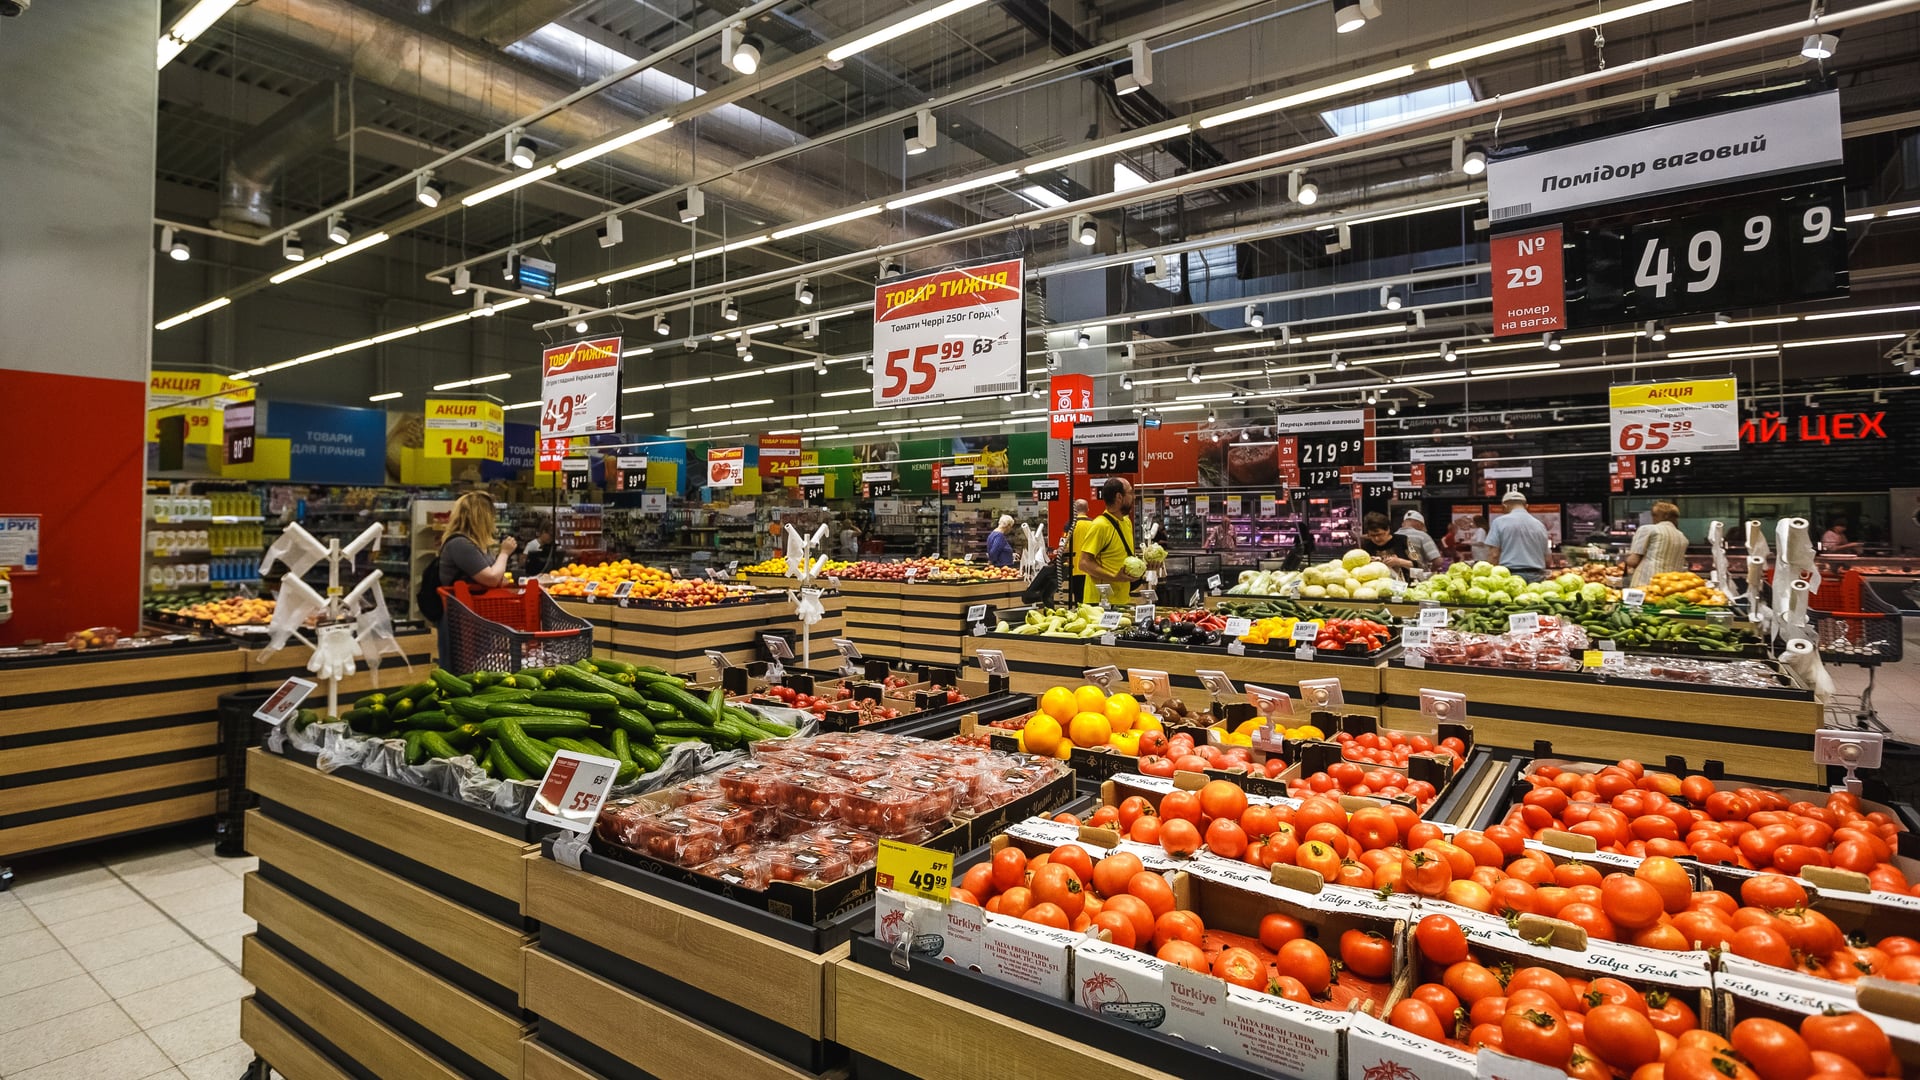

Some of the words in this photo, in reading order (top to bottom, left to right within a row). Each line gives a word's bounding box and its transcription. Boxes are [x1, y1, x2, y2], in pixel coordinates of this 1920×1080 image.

[1541, 159, 1646, 193] Помідор
[1652, 135, 1767, 171] ваговий
[1634, 230, 1723, 299] 49
[1506, 265, 1543, 290] 29
[885, 284, 937, 309] ТОВАР
[940, 271, 1008, 298] ТИЖНЯ
[1507, 304, 1551, 318] номер
[891, 321, 920, 333] Томати
[921, 315, 945, 328] Черрі
[946, 313, 967, 324] 250г
[1501, 319, 1518, 330] на
[1520, 315, 1557, 329] вагах
[549, 352, 576, 367] ТОВАР
[577, 345, 613, 362] ТИЖНЯ
[882, 344, 939, 398] 55
[941, 341, 964, 360] 99
[150, 377, 201, 392] АКЦІЯ
[436, 404, 477, 417] АКЦІЯ
[542, 395, 574, 432] 49
[1053, 414, 1077, 423] ВАГИ
[1080, 414, 1093, 423] ВАГИ
[191, 416, 209, 427] 99
[1799, 411, 1887, 445] ЦЕХ
[307, 431, 353, 443] ТОВАРИ
[1619, 422, 1670, 451] 65
[291, 443, 317, 454] ДЛЯ
[319, 446, 366, 457] ПРАННЯ
[442, 438, 468, 456] 14
[469, 435, 484, 444] 49
[1303, 443, 1337, 463] 219
[1100, 453, 1117, 470] 59
[1147, 451, 1174, 460] М'ЯСО
[770, 462, 789, 473] 24
[1640, 459, 1671, 475] 168
[1310, 471, 1324, 484] 12
[1438, 469, 1453, 482] 19
[1634, 478, 1649, 489] 32
[1369, 486, 1381, 496] 35
[7, 521, 37, 531] РУК
[569, 791, 593, 812] 55
[1189, 861, 1218, 876] Talya
[1219, 869, 1250, 883] Fresh
[909, 870, 935, 892] 49
[935, 875, 947, 886] 99
[1319, 892, 1352, 906] Talya
[1354, 898, 1389, 912] Fresh
[947, 914, 982, 932] Türkiye
[994, 940, 1011, 950] TALYA
[1011, 945, 1031, 956] FRESH
[1587, 954, 1630, 972] Talya
[1635, 963, 1679, 979] Fresh
[1170, 994, 1195, 1007] Discover
[1171, 981, 1217, 1005] Türkiye
[1723, 977, 1770, 998] Talya
[1776, 991, 1825, 1012] Fresh
[1170, 1001, 1180, 1009] the
[1179, 1004, 1205, 1017] potential
[1259, 996, 1300, 1012] Fresh
[1303, 1009, 1346, 1025] Talya
[1236, 1015, 1259, 1028] TALYA
[1260, 1022, 1287, 1036] FRESH
[1288, 1032, 1315, 1045] TARIM
[1295, 1041, 1313, 1052] LTD.
[1380, 1030, 1428, 1049] Fresh
